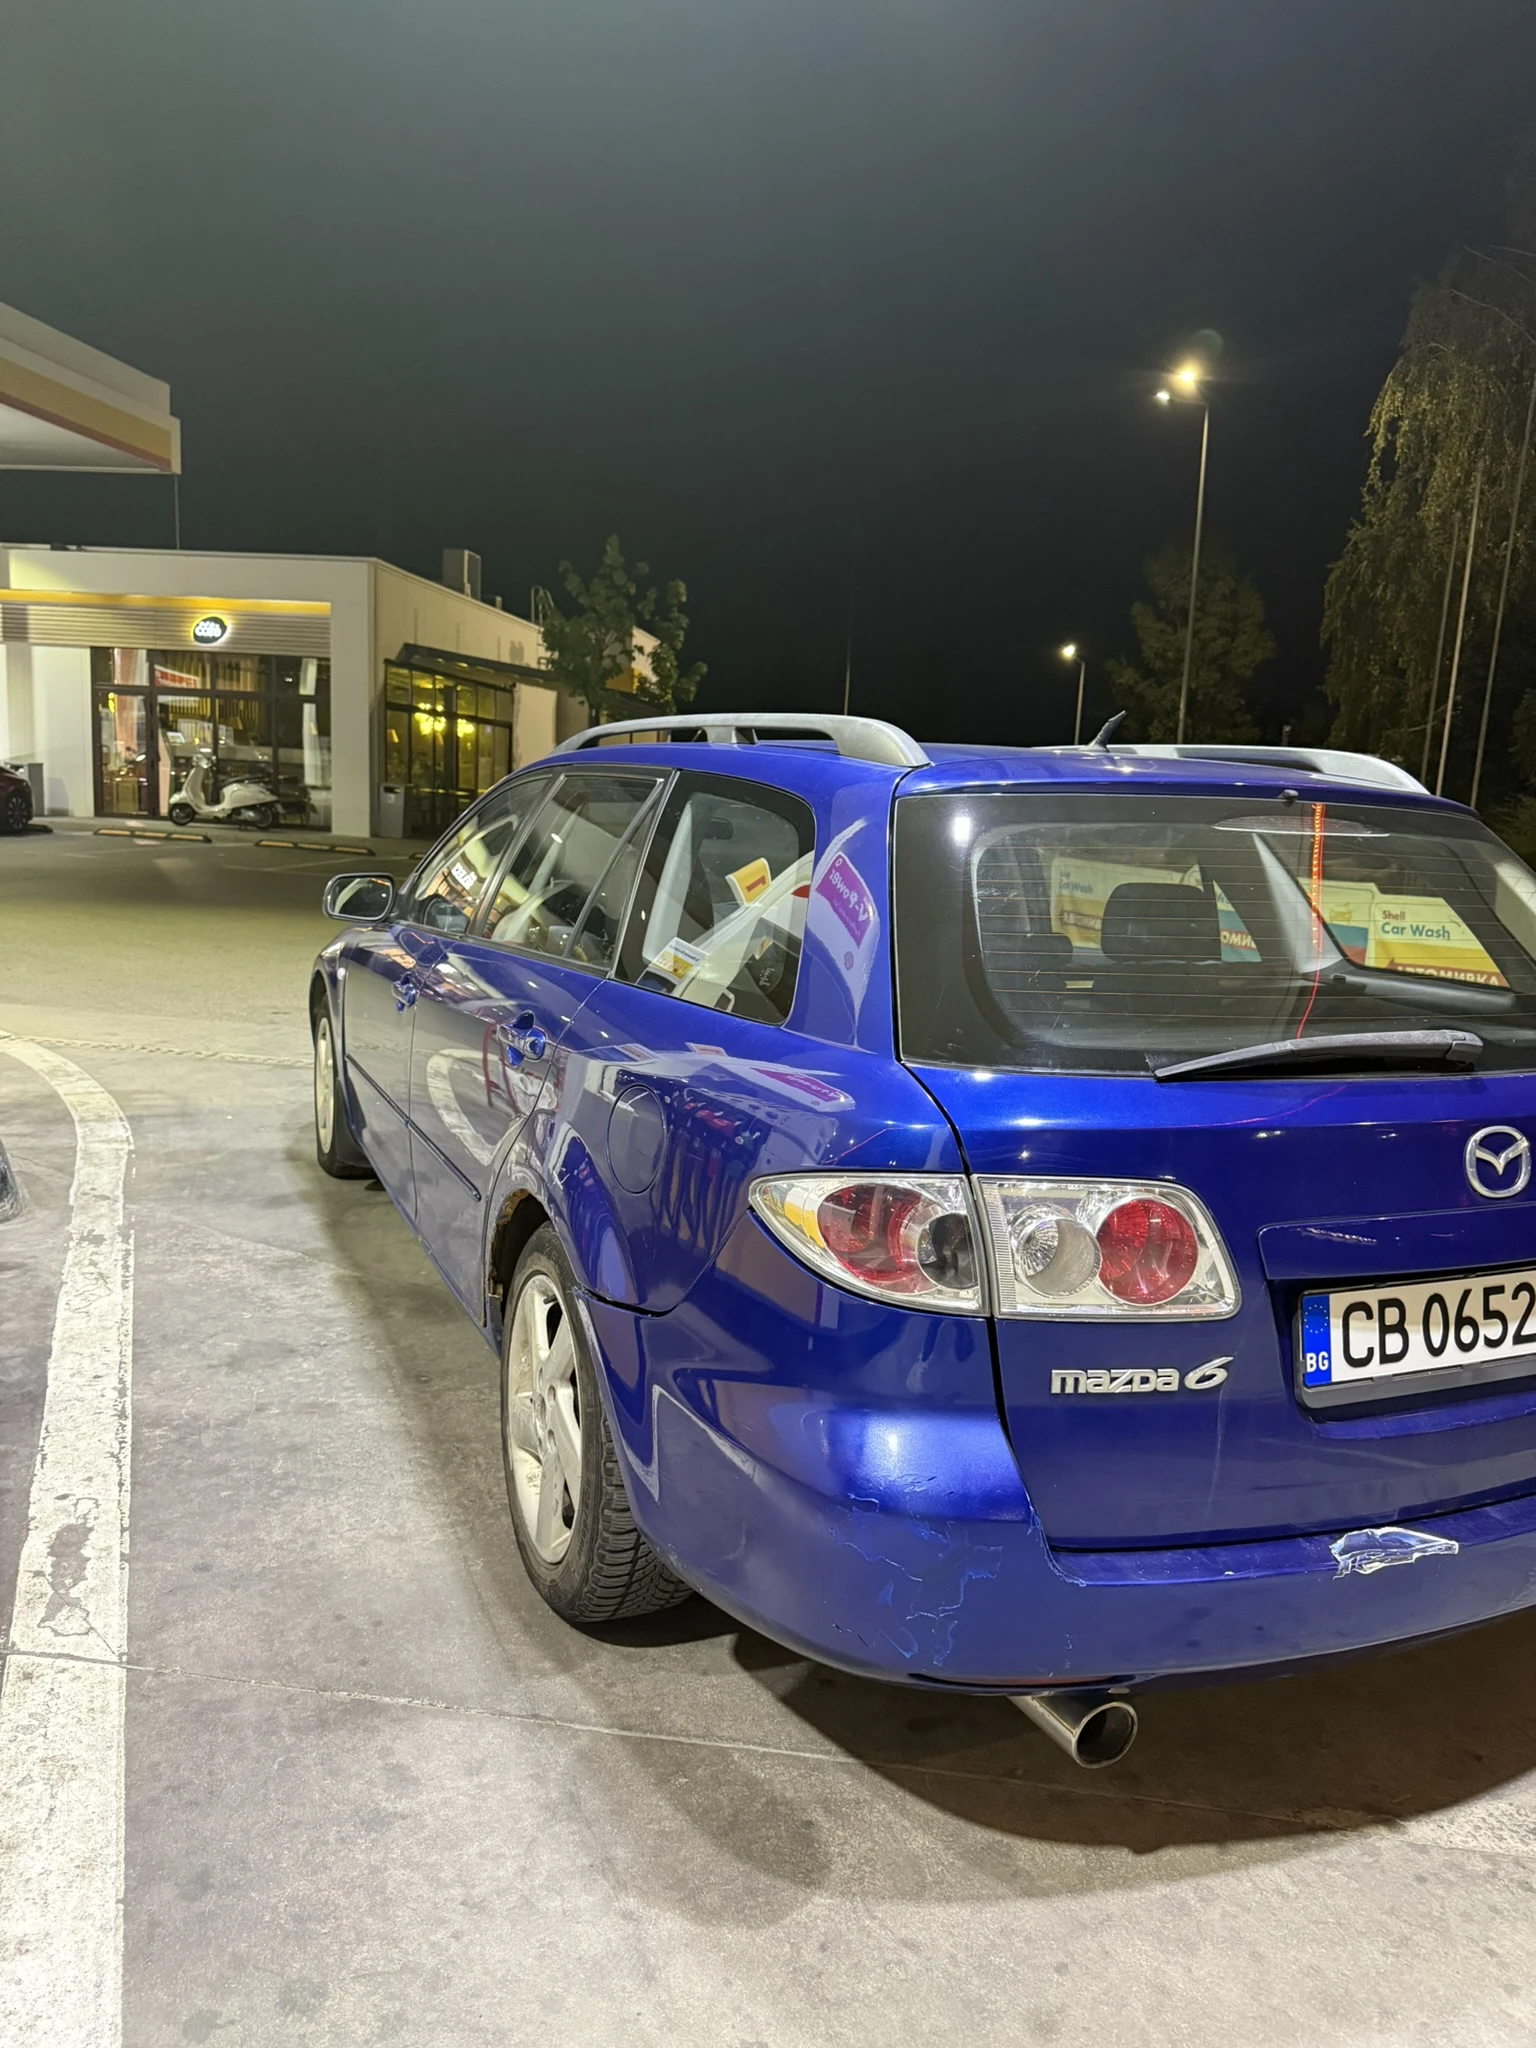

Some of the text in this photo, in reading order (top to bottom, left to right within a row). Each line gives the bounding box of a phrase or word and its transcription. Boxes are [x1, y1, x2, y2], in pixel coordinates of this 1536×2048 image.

[1382, 910, 1406, 921] Shell
[1381, 922, 1451, 940] Car Wash
[1342, 1282, 1536, 1368] CB 0652
[1306, 1351, 1330, 1373] BG
